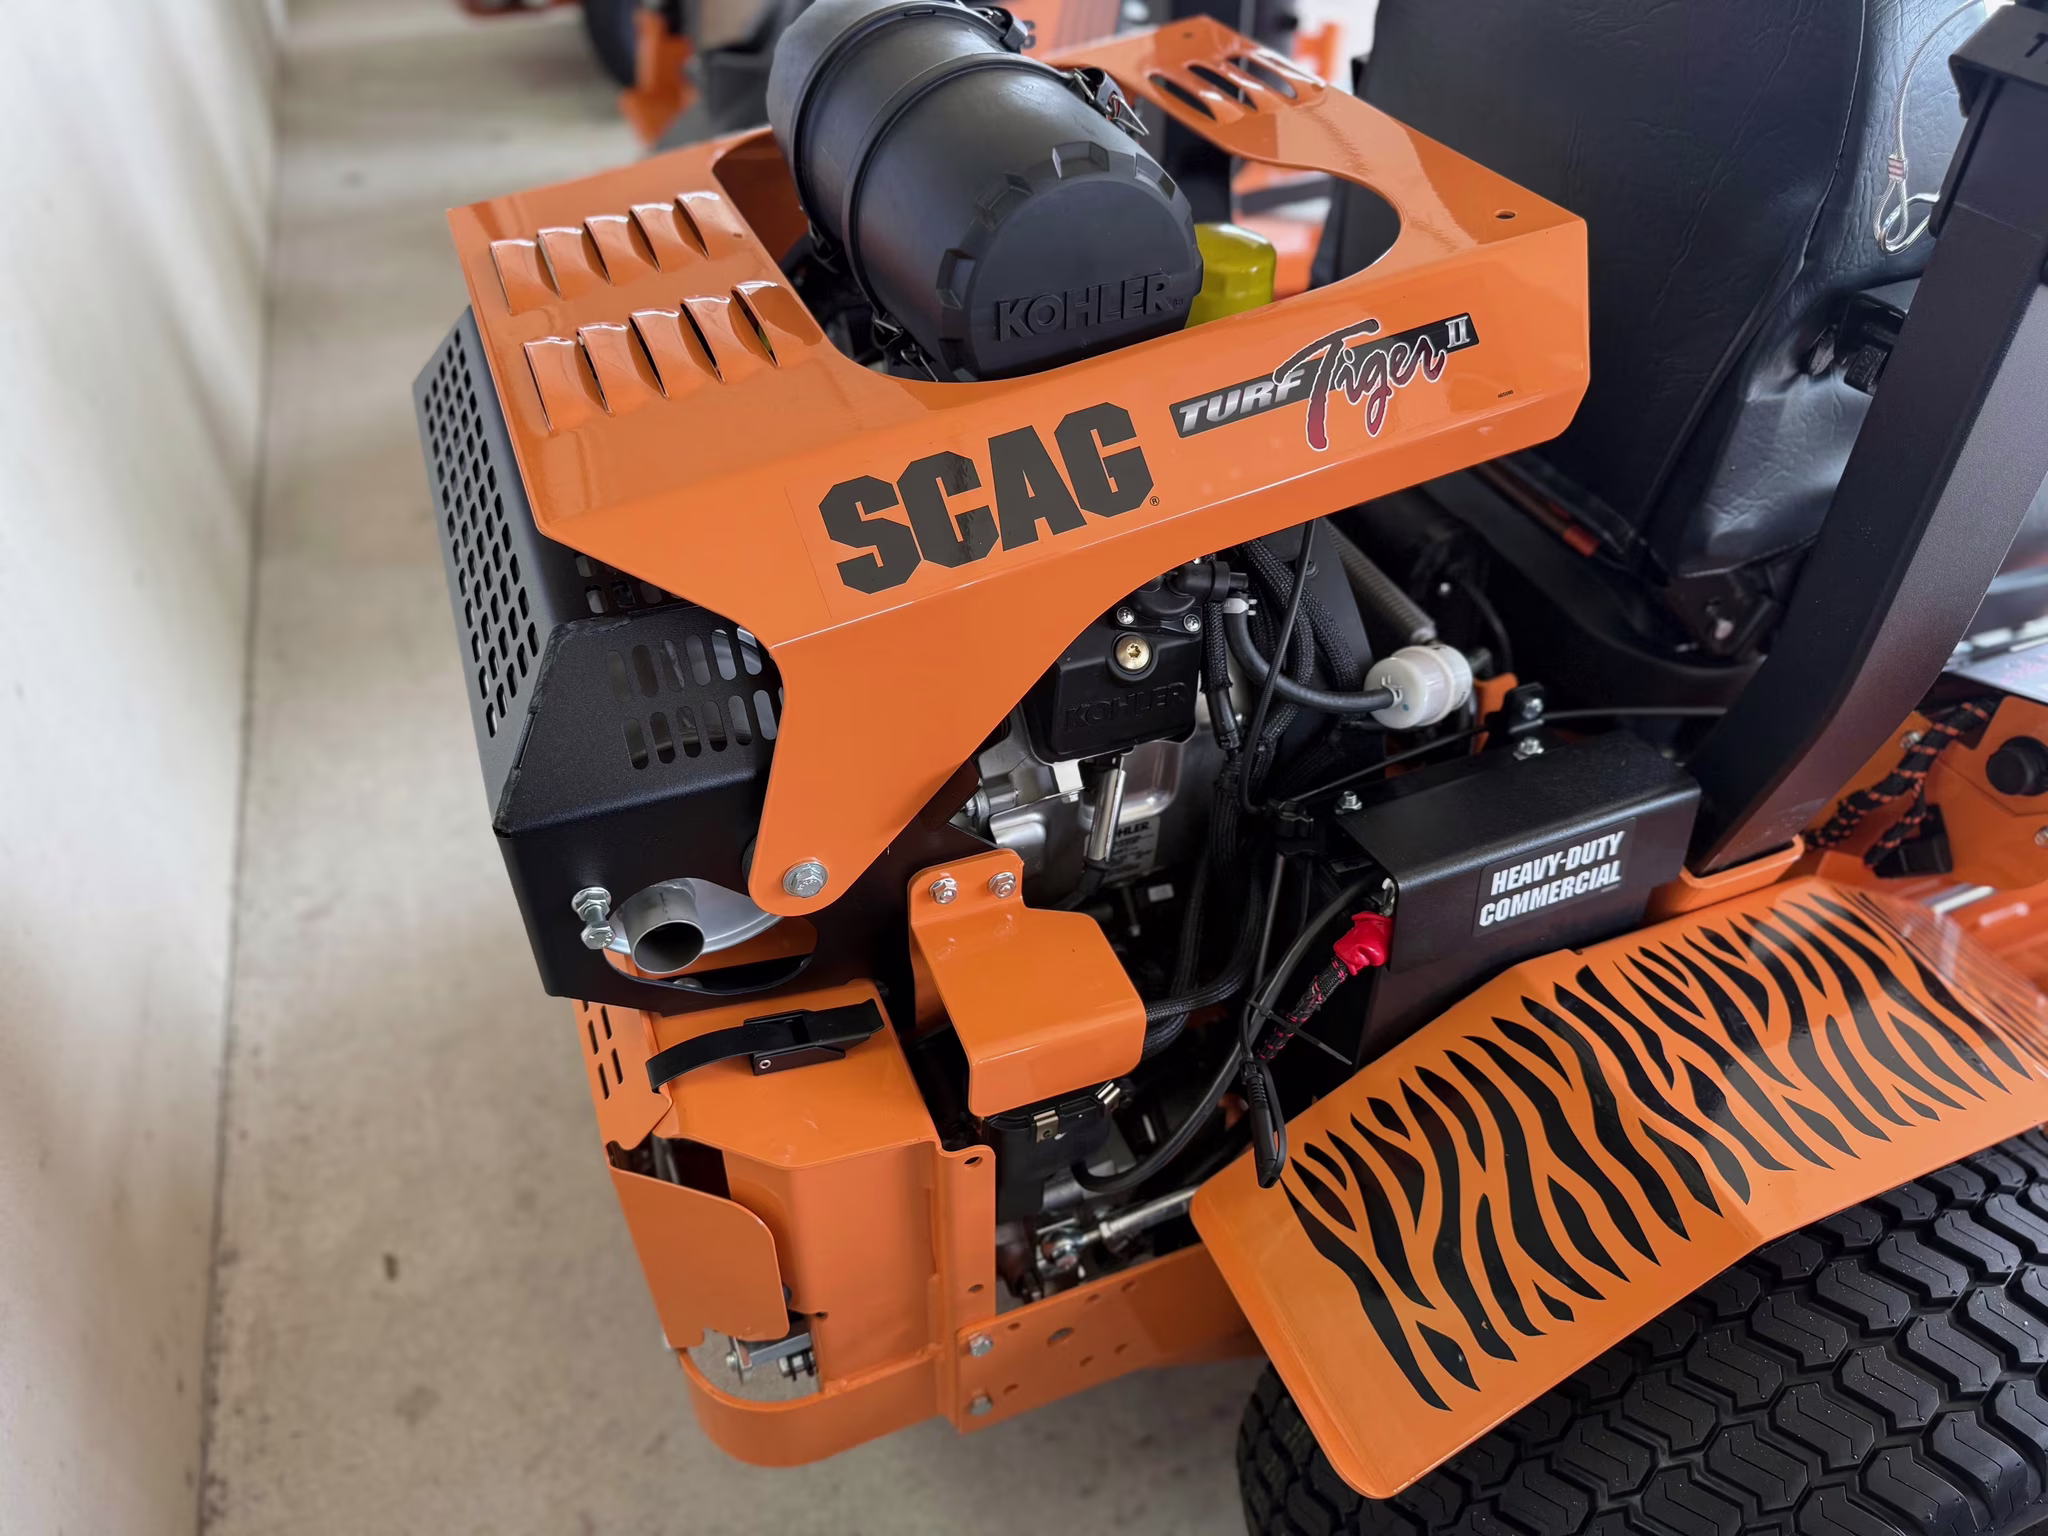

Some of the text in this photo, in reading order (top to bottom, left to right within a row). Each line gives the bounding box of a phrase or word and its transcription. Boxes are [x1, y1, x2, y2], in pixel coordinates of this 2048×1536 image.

[995, 273, 1174, 342] KOHLER
[1178, 316, 1471, 451] TURF Tiger II
[818, 402, 1154, 594] SCAG
[1066, 682, 1190, 730] KOHLER
[1479, 860, 1622, 927] COMMERCIAL
[1490, 831, 1625, 896] HEAVY-DUTY
